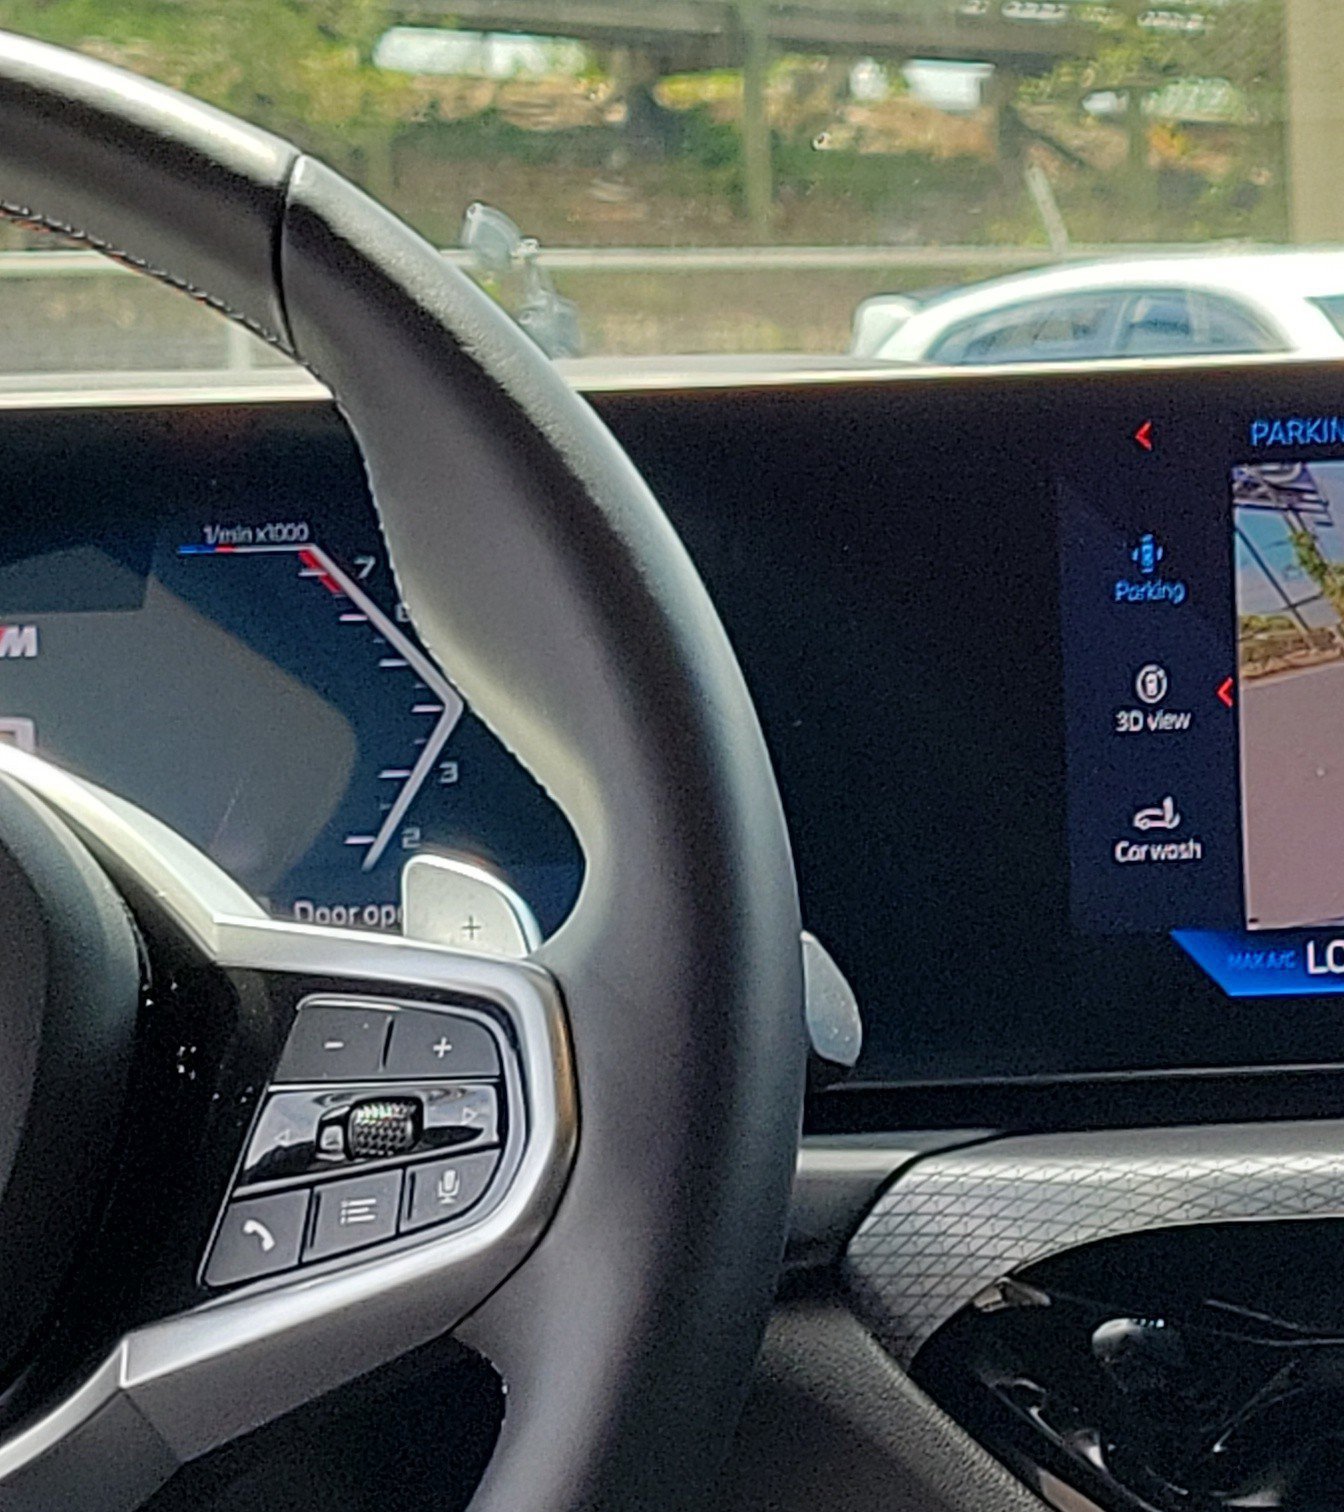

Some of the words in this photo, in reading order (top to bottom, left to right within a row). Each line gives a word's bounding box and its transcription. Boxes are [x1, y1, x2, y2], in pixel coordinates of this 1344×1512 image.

[204, 525, 253, 545] 1/min
[354, 556, 376, 579] 7
[1114, 580, 1186, 605] Parking
[1115, 709, 1144, 732] 3D
[1147, 709, 1191, 732] view
[439, 761, 459, 784] 3
[402, 827, 421, 849] 2
[1114, 839, 1148, 864] Car
[1149, 837, 1202, 862] wash
[294, 900, 360, 926] Door
